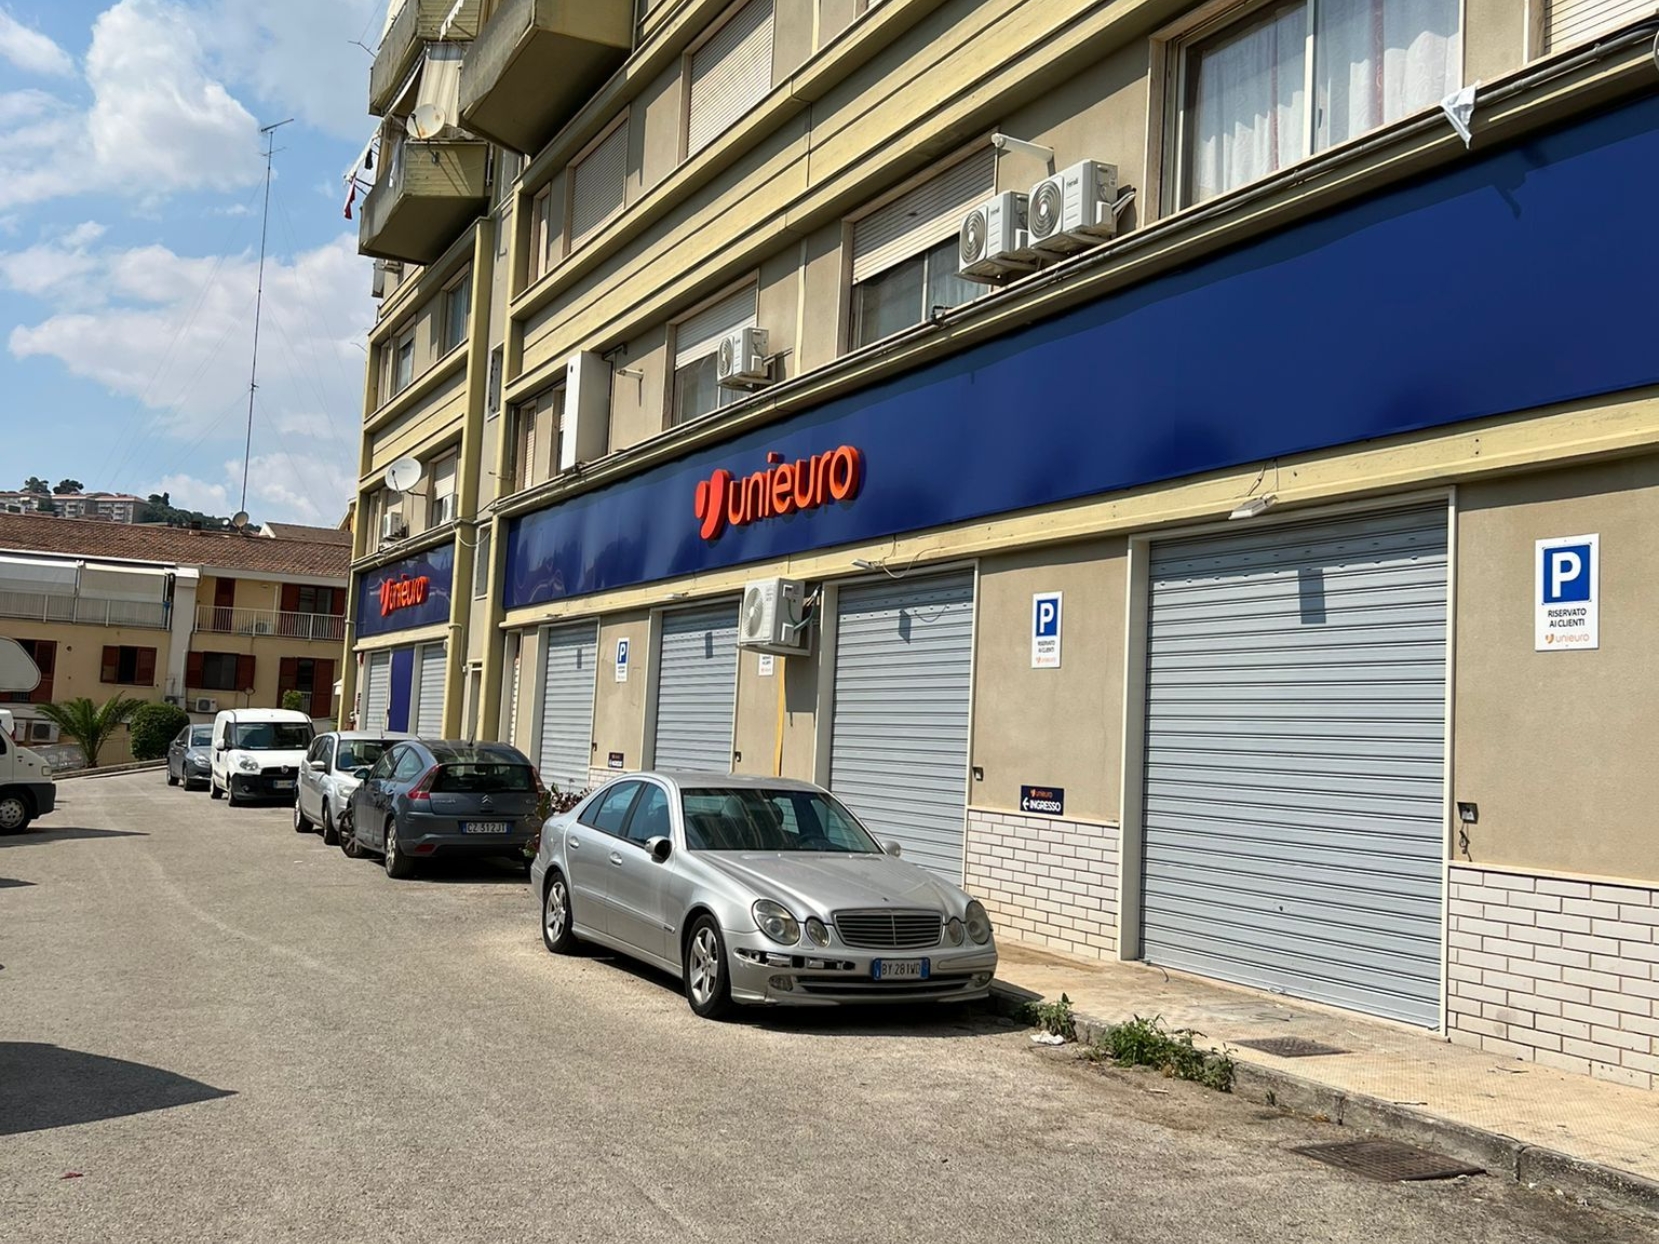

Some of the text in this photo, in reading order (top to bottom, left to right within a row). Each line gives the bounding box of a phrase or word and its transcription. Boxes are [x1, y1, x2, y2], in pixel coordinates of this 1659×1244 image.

[728, 445, 858, 526] unieuro
[1551, 551, 1582, 598] P
[1040, 602, 1054, 633] P
[1548, 608, 1587, 617] RISERVATO
[1549, 618, 1585, 628] AI CLIENTI
[1556, 633, 1590, 642] unieuro
[619, 643, 626, 661] P
[1030, 799, 1061, 812] INGRESSO
